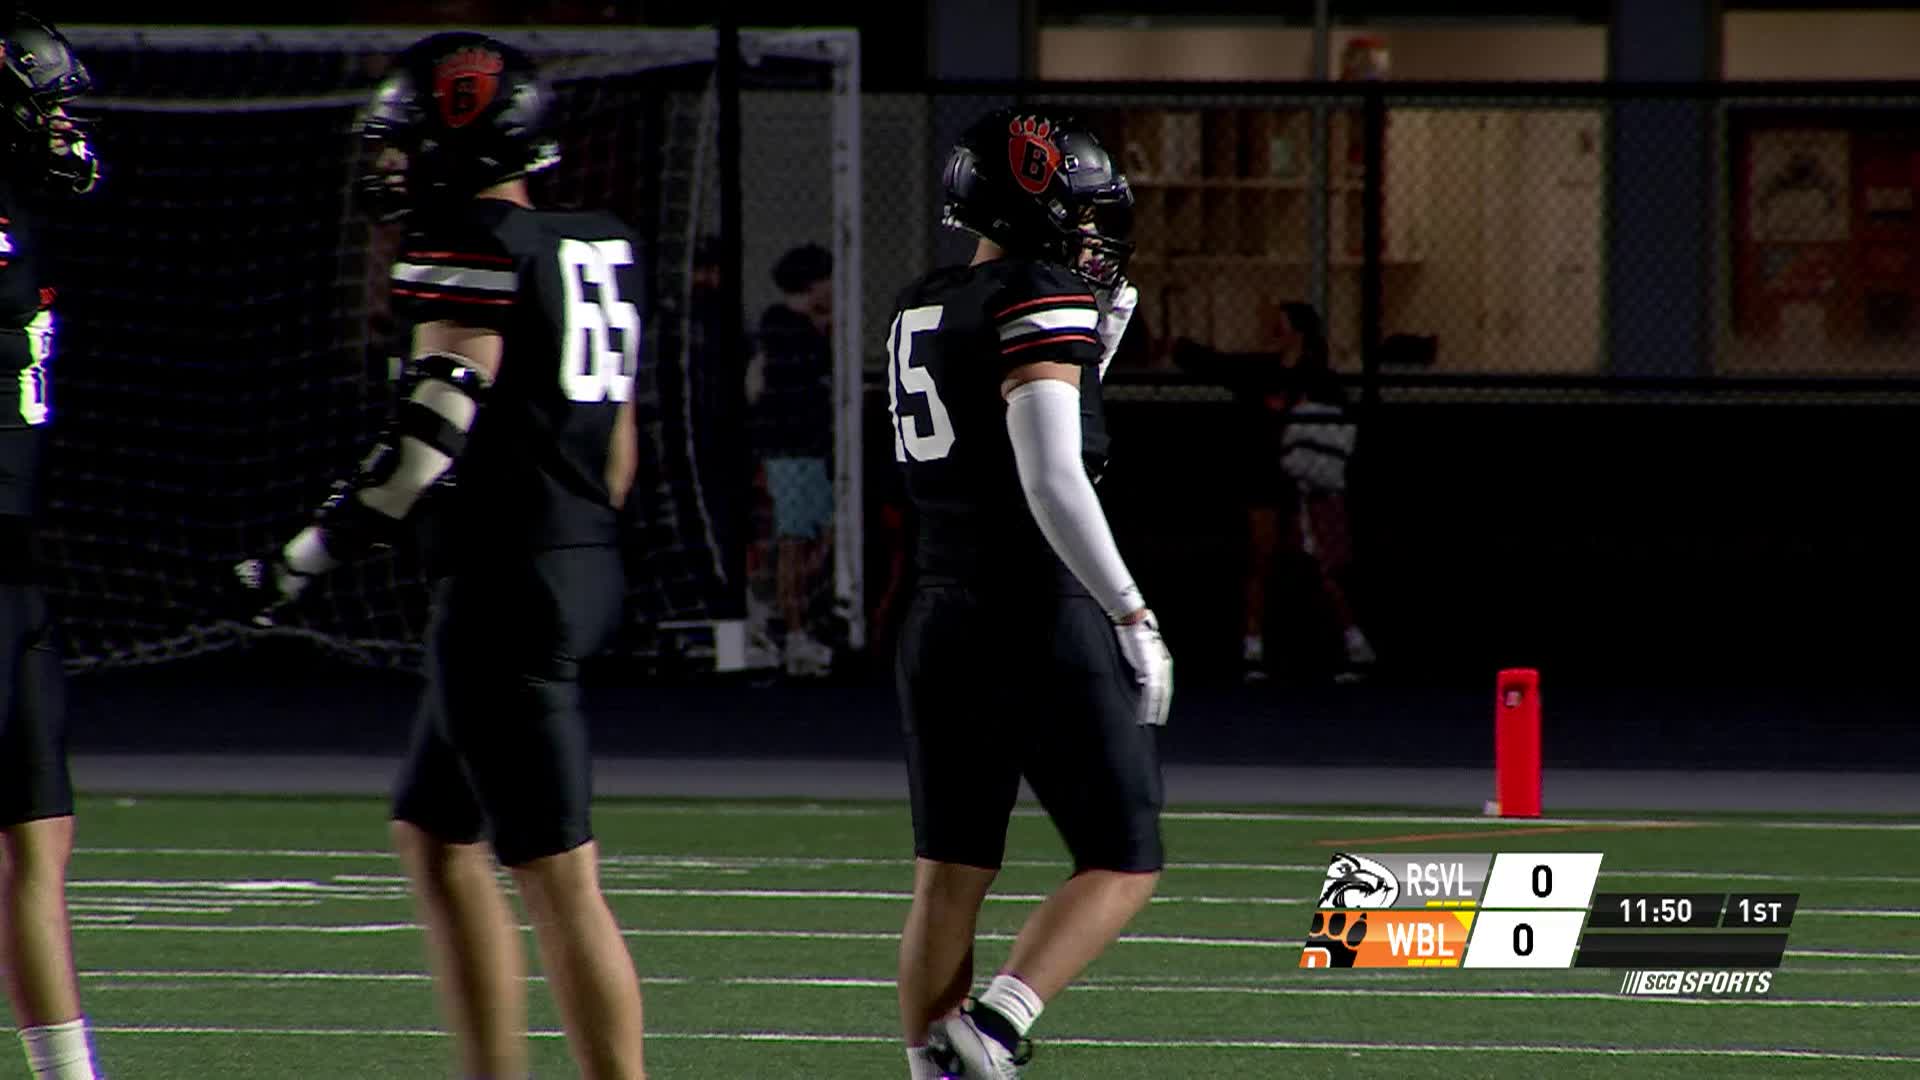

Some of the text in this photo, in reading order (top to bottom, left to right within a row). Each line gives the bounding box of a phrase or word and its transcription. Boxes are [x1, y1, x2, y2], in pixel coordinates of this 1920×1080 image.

[1021, 140, 1049, 184] B
[558, 238, 641, 402] 65
[886, 305, 956, 463] 15
